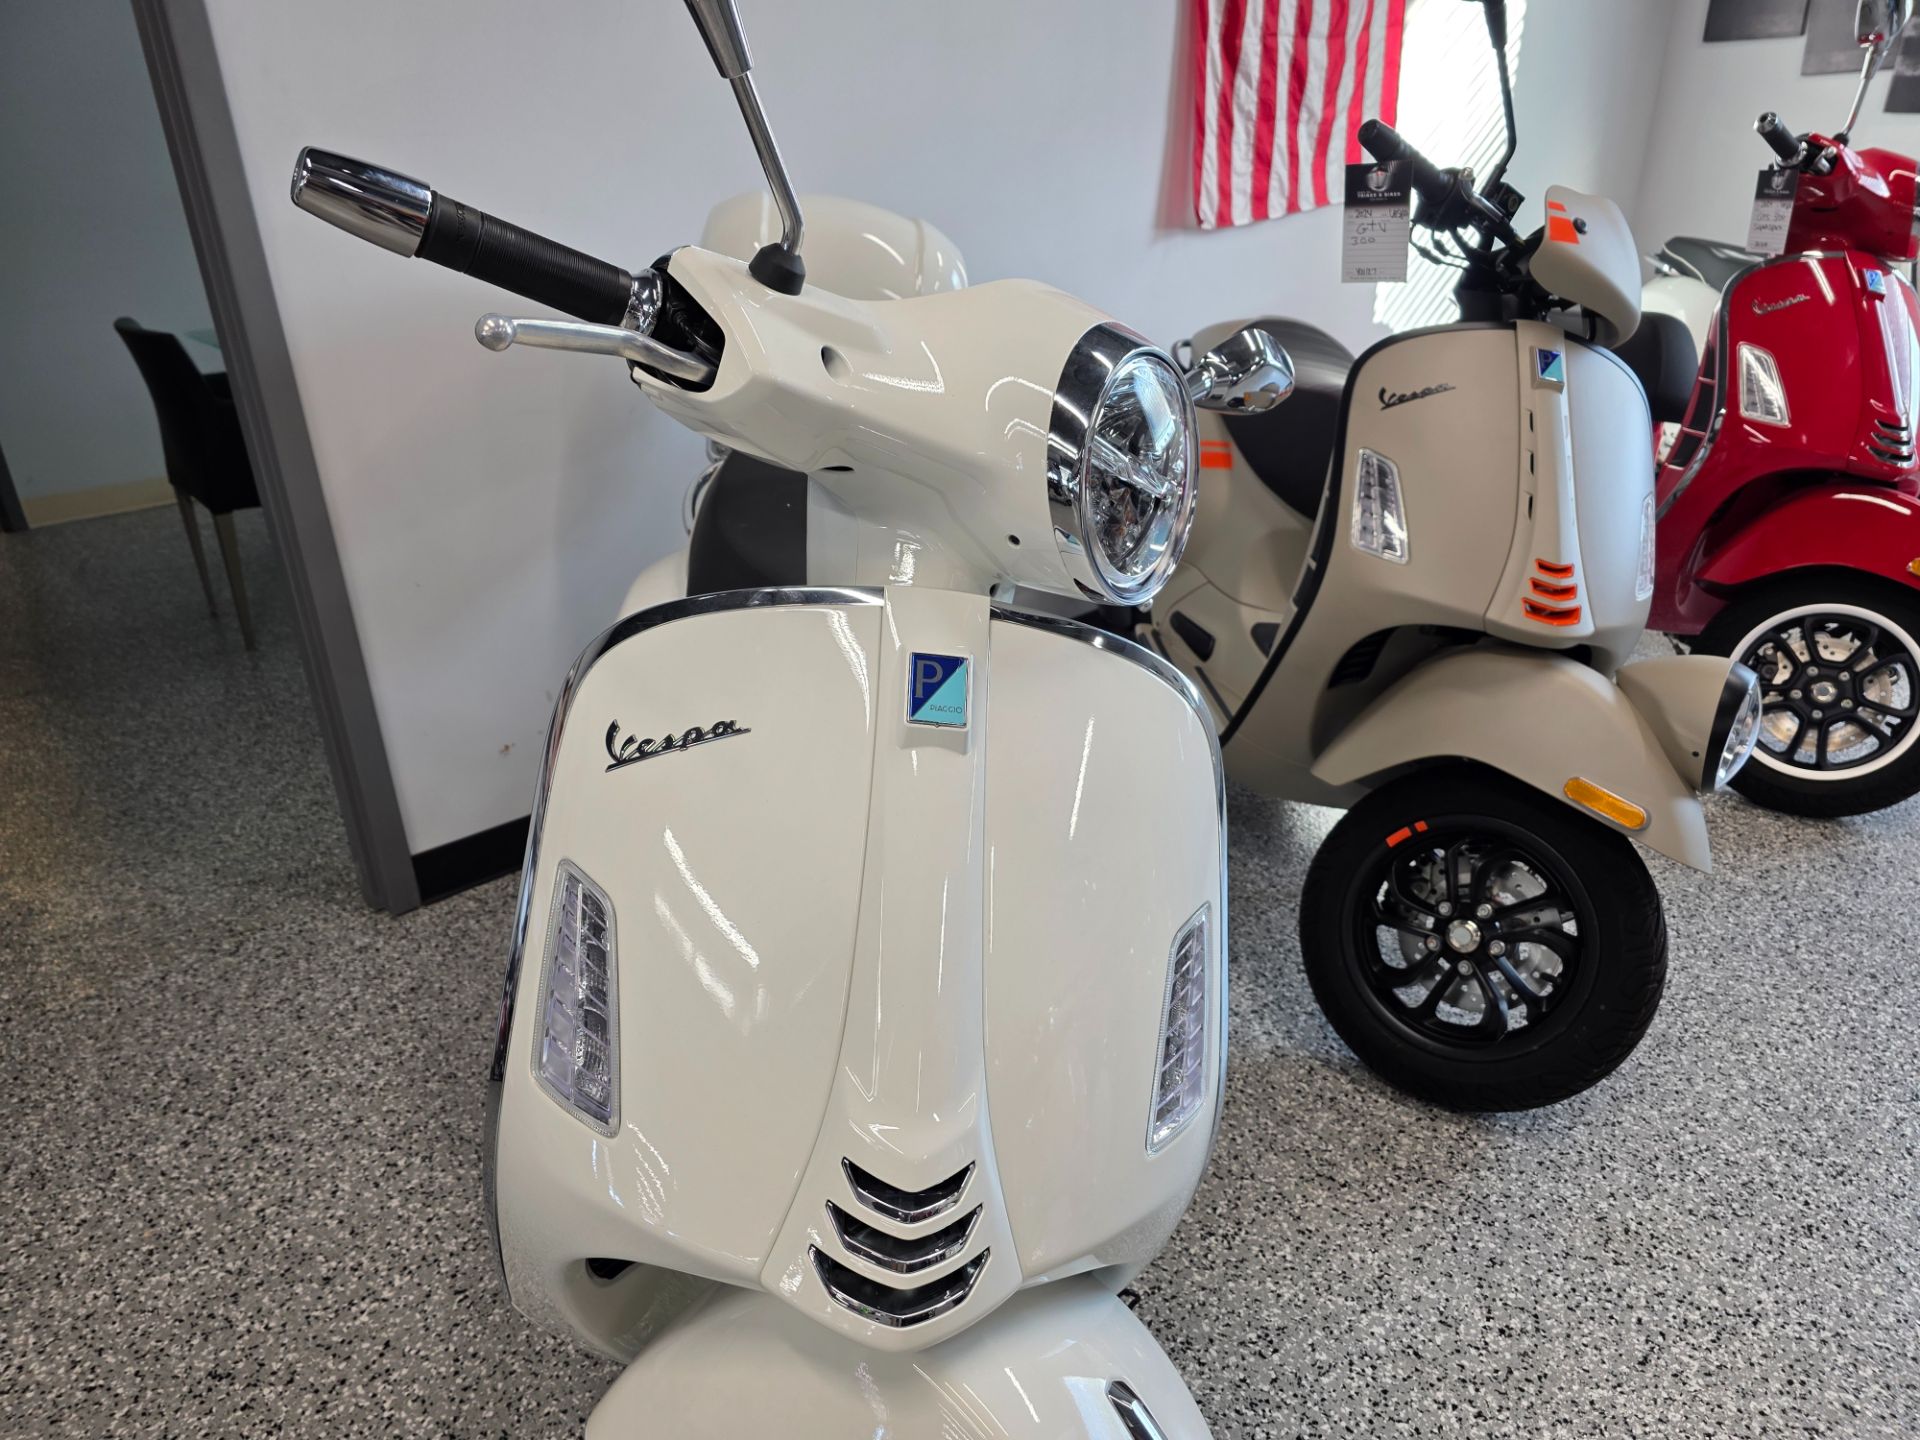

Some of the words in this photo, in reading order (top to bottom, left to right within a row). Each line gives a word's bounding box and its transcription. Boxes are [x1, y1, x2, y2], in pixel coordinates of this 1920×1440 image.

[1351, 236, 1376, 246] 300
[1378, 383, 1457, 412] Vespa
[914, 660, 944, 699] P
[929, 704, 963, 714] PIAGGIO
[605, 719, 752, 773] Vespa
